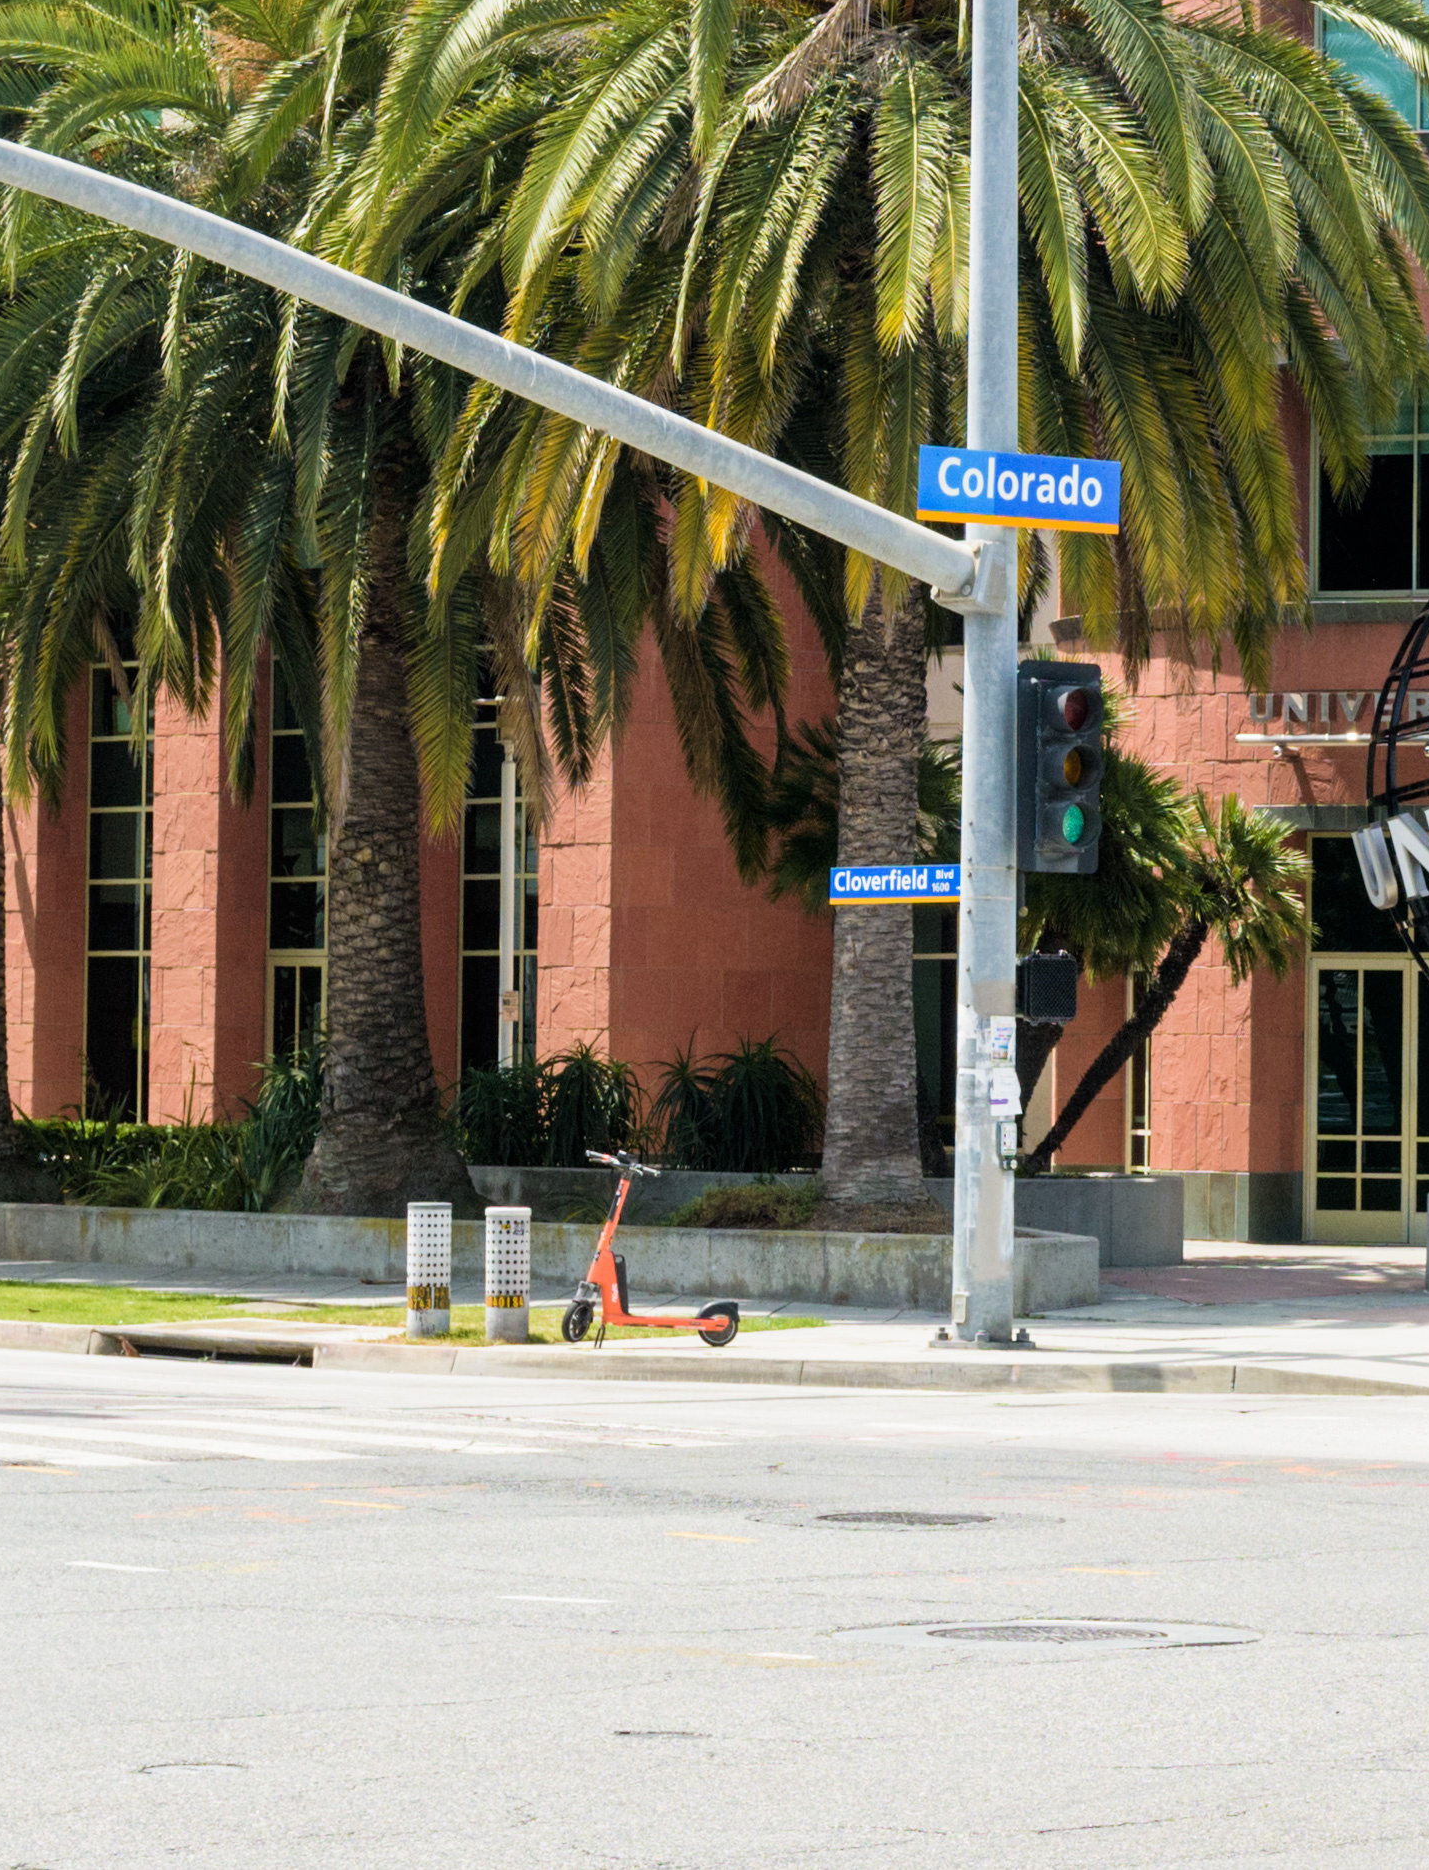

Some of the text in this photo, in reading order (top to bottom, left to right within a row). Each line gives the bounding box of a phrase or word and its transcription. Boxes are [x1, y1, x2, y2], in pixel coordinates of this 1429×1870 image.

[937, 456, 1103, 507] Colorado
[834, 868, 954, 892] Cloverfield Blvd
[932, 882, 950, 893] 1600
